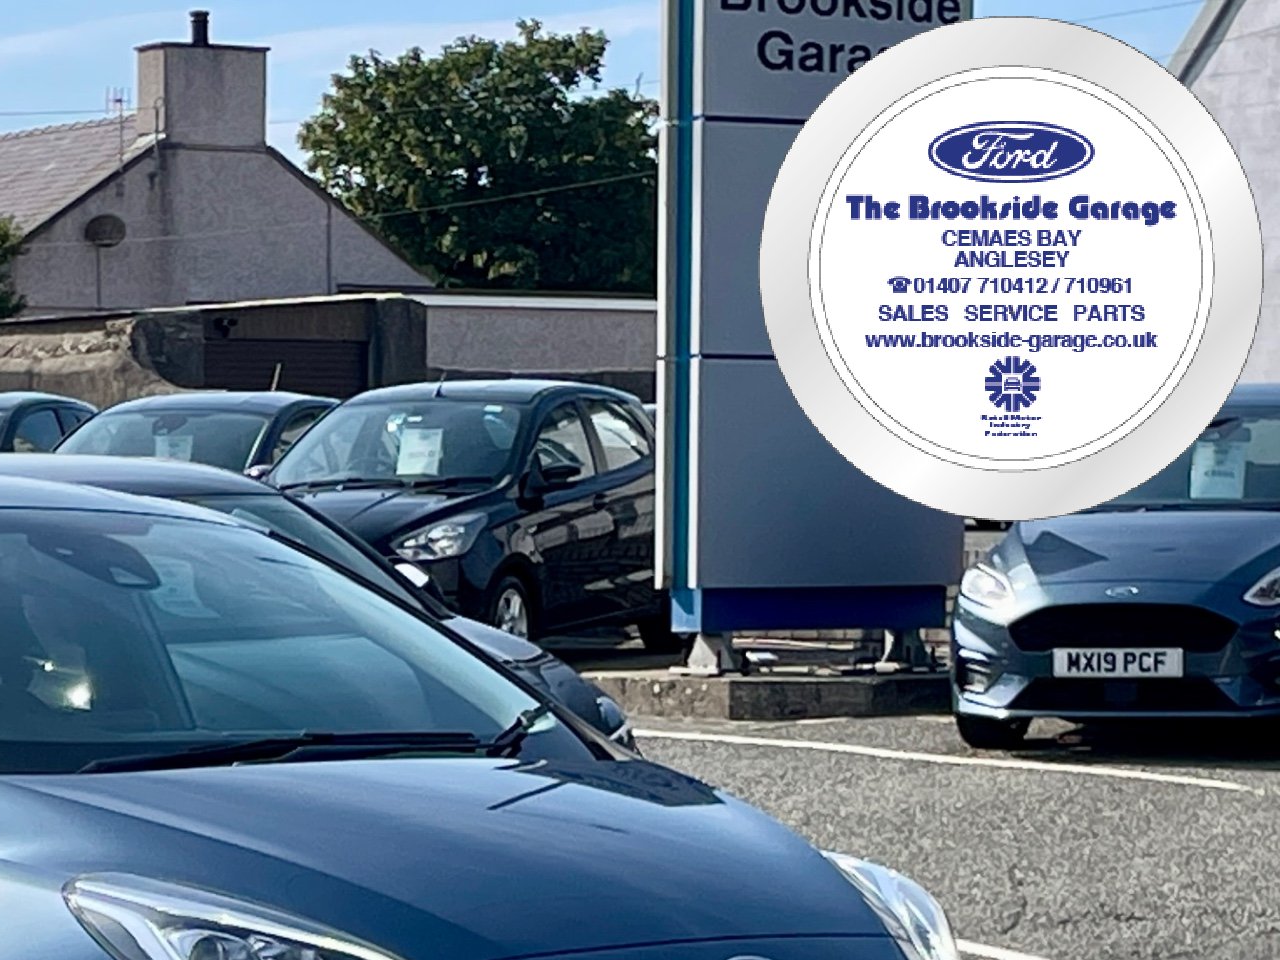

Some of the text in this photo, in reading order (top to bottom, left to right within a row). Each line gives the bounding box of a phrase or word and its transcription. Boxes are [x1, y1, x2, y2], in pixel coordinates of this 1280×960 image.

[757, 30, 888, 74] Gara
[1066, 652, 1167, 673] MX19 PCF
